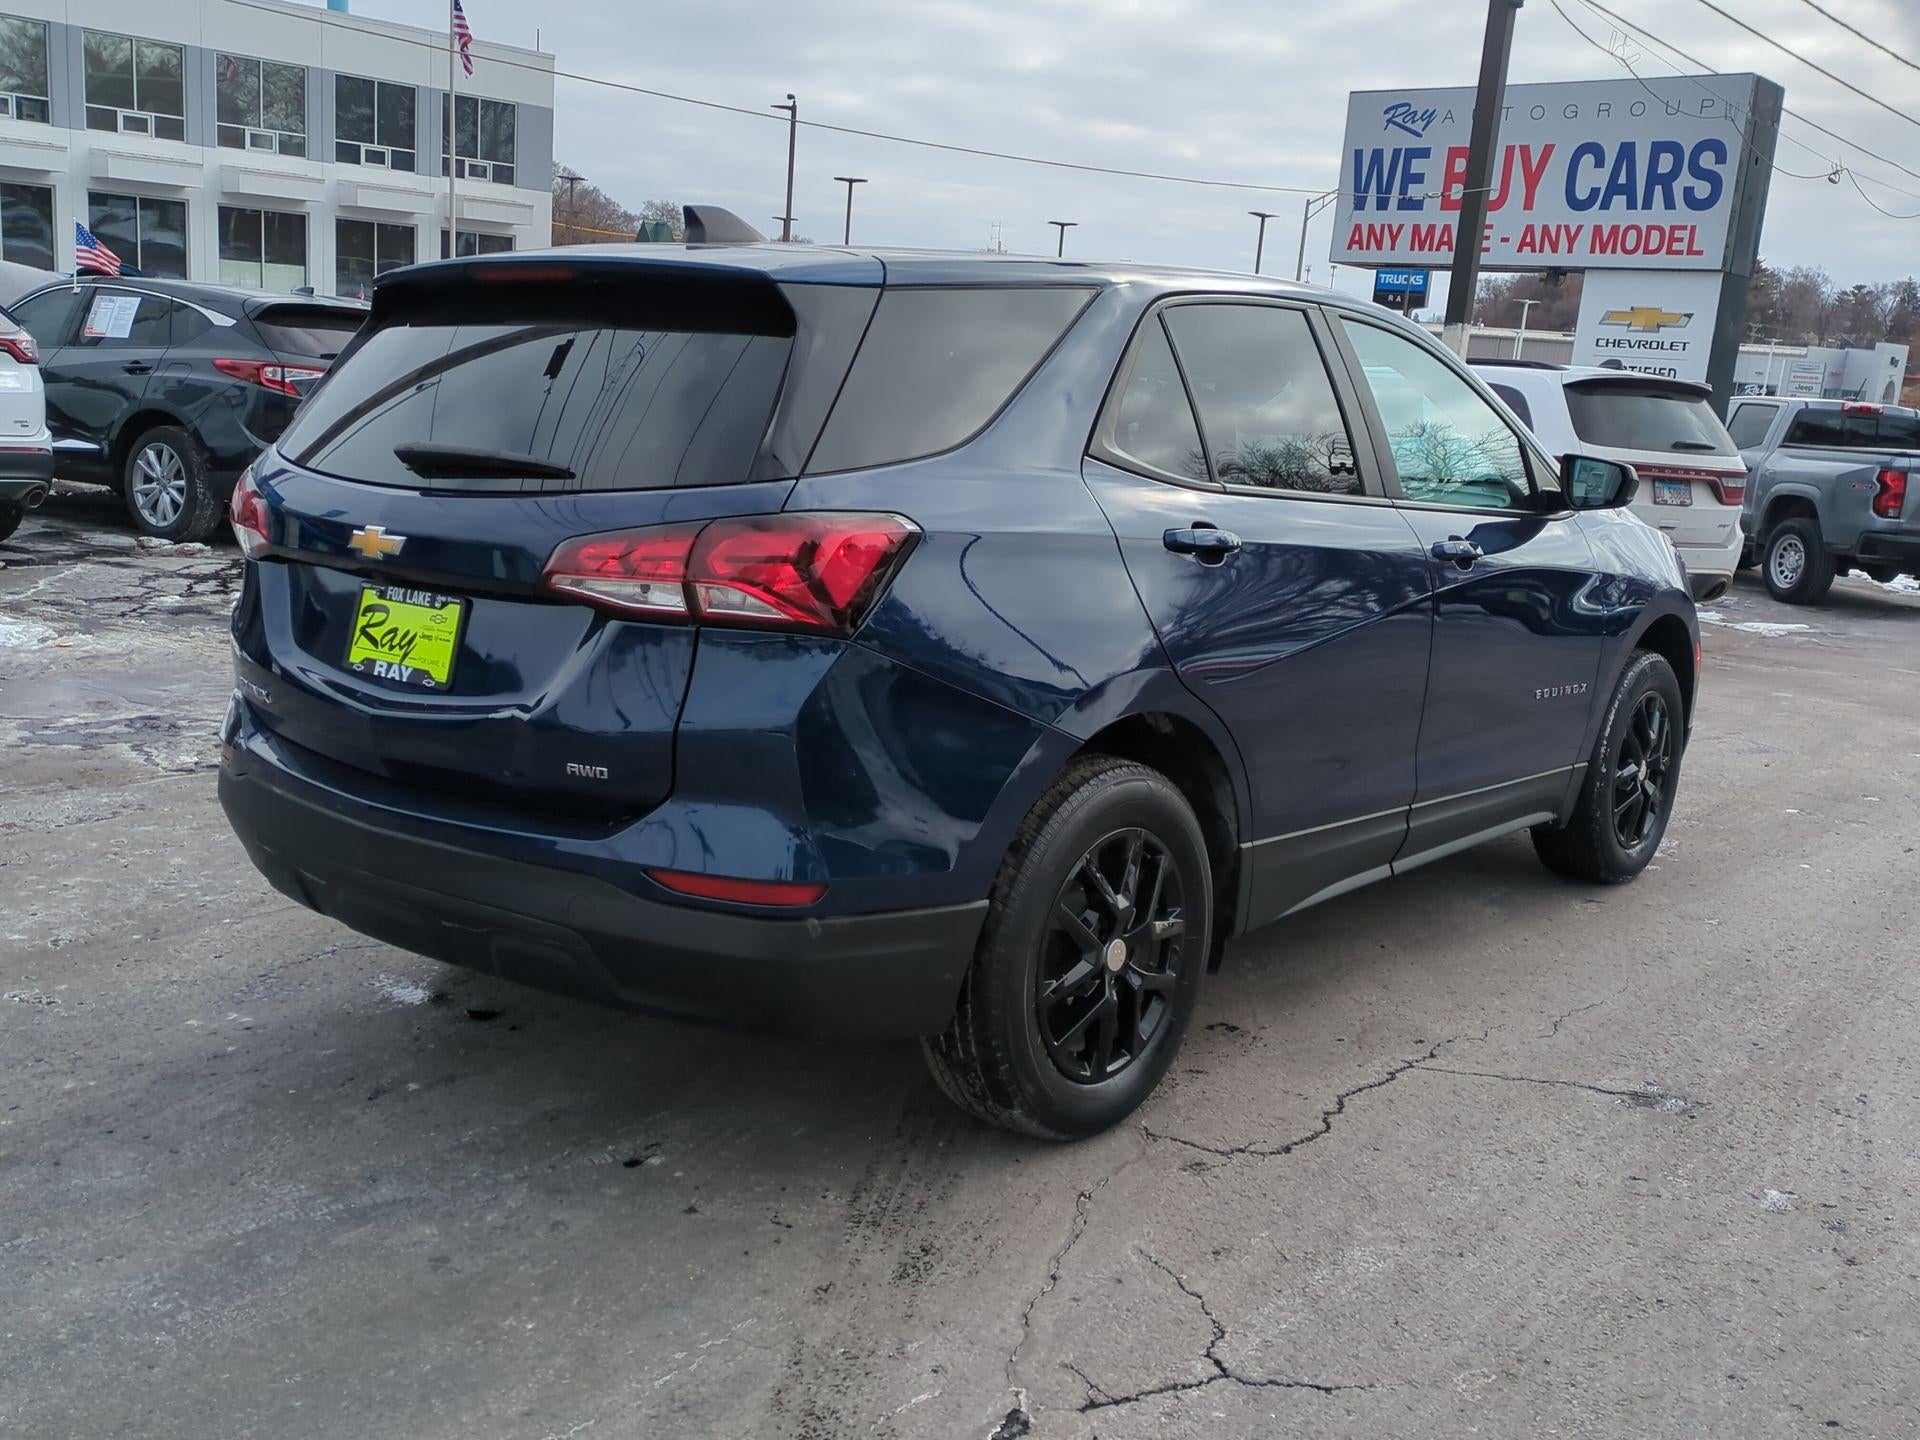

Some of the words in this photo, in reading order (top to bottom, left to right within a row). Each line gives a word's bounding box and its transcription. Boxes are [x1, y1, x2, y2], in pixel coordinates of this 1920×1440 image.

[1383, 102, 1438, 138] Ray
[1441, 98, 1715, 125] ATOGROUP
[1353, 147, 1432, 211] WE
[1565, 138, 1728, 212] CARS
[1347, 223, 1405, 251] ANY
[1409, 223, 1494, 253] MAE
[1516, 223, 1584, 254] ANY
[1589, 224, 1704, 256] MODEL
[1380, 273, 1424, 286] TRUCKS
[1595, 337, 1690, 351] CHEVROLET
[1795, 384, 1814, 392] Jeep
[386, 586, 404, 602] FOX
[405, 589, 432, 607] LAKE
[354, 603, 418, 664] Ray
[373, 660, 413, 682] RAY
[1536, 683, 1587, 700] EQUINOX
[566, 763, 608, 779] AWD
